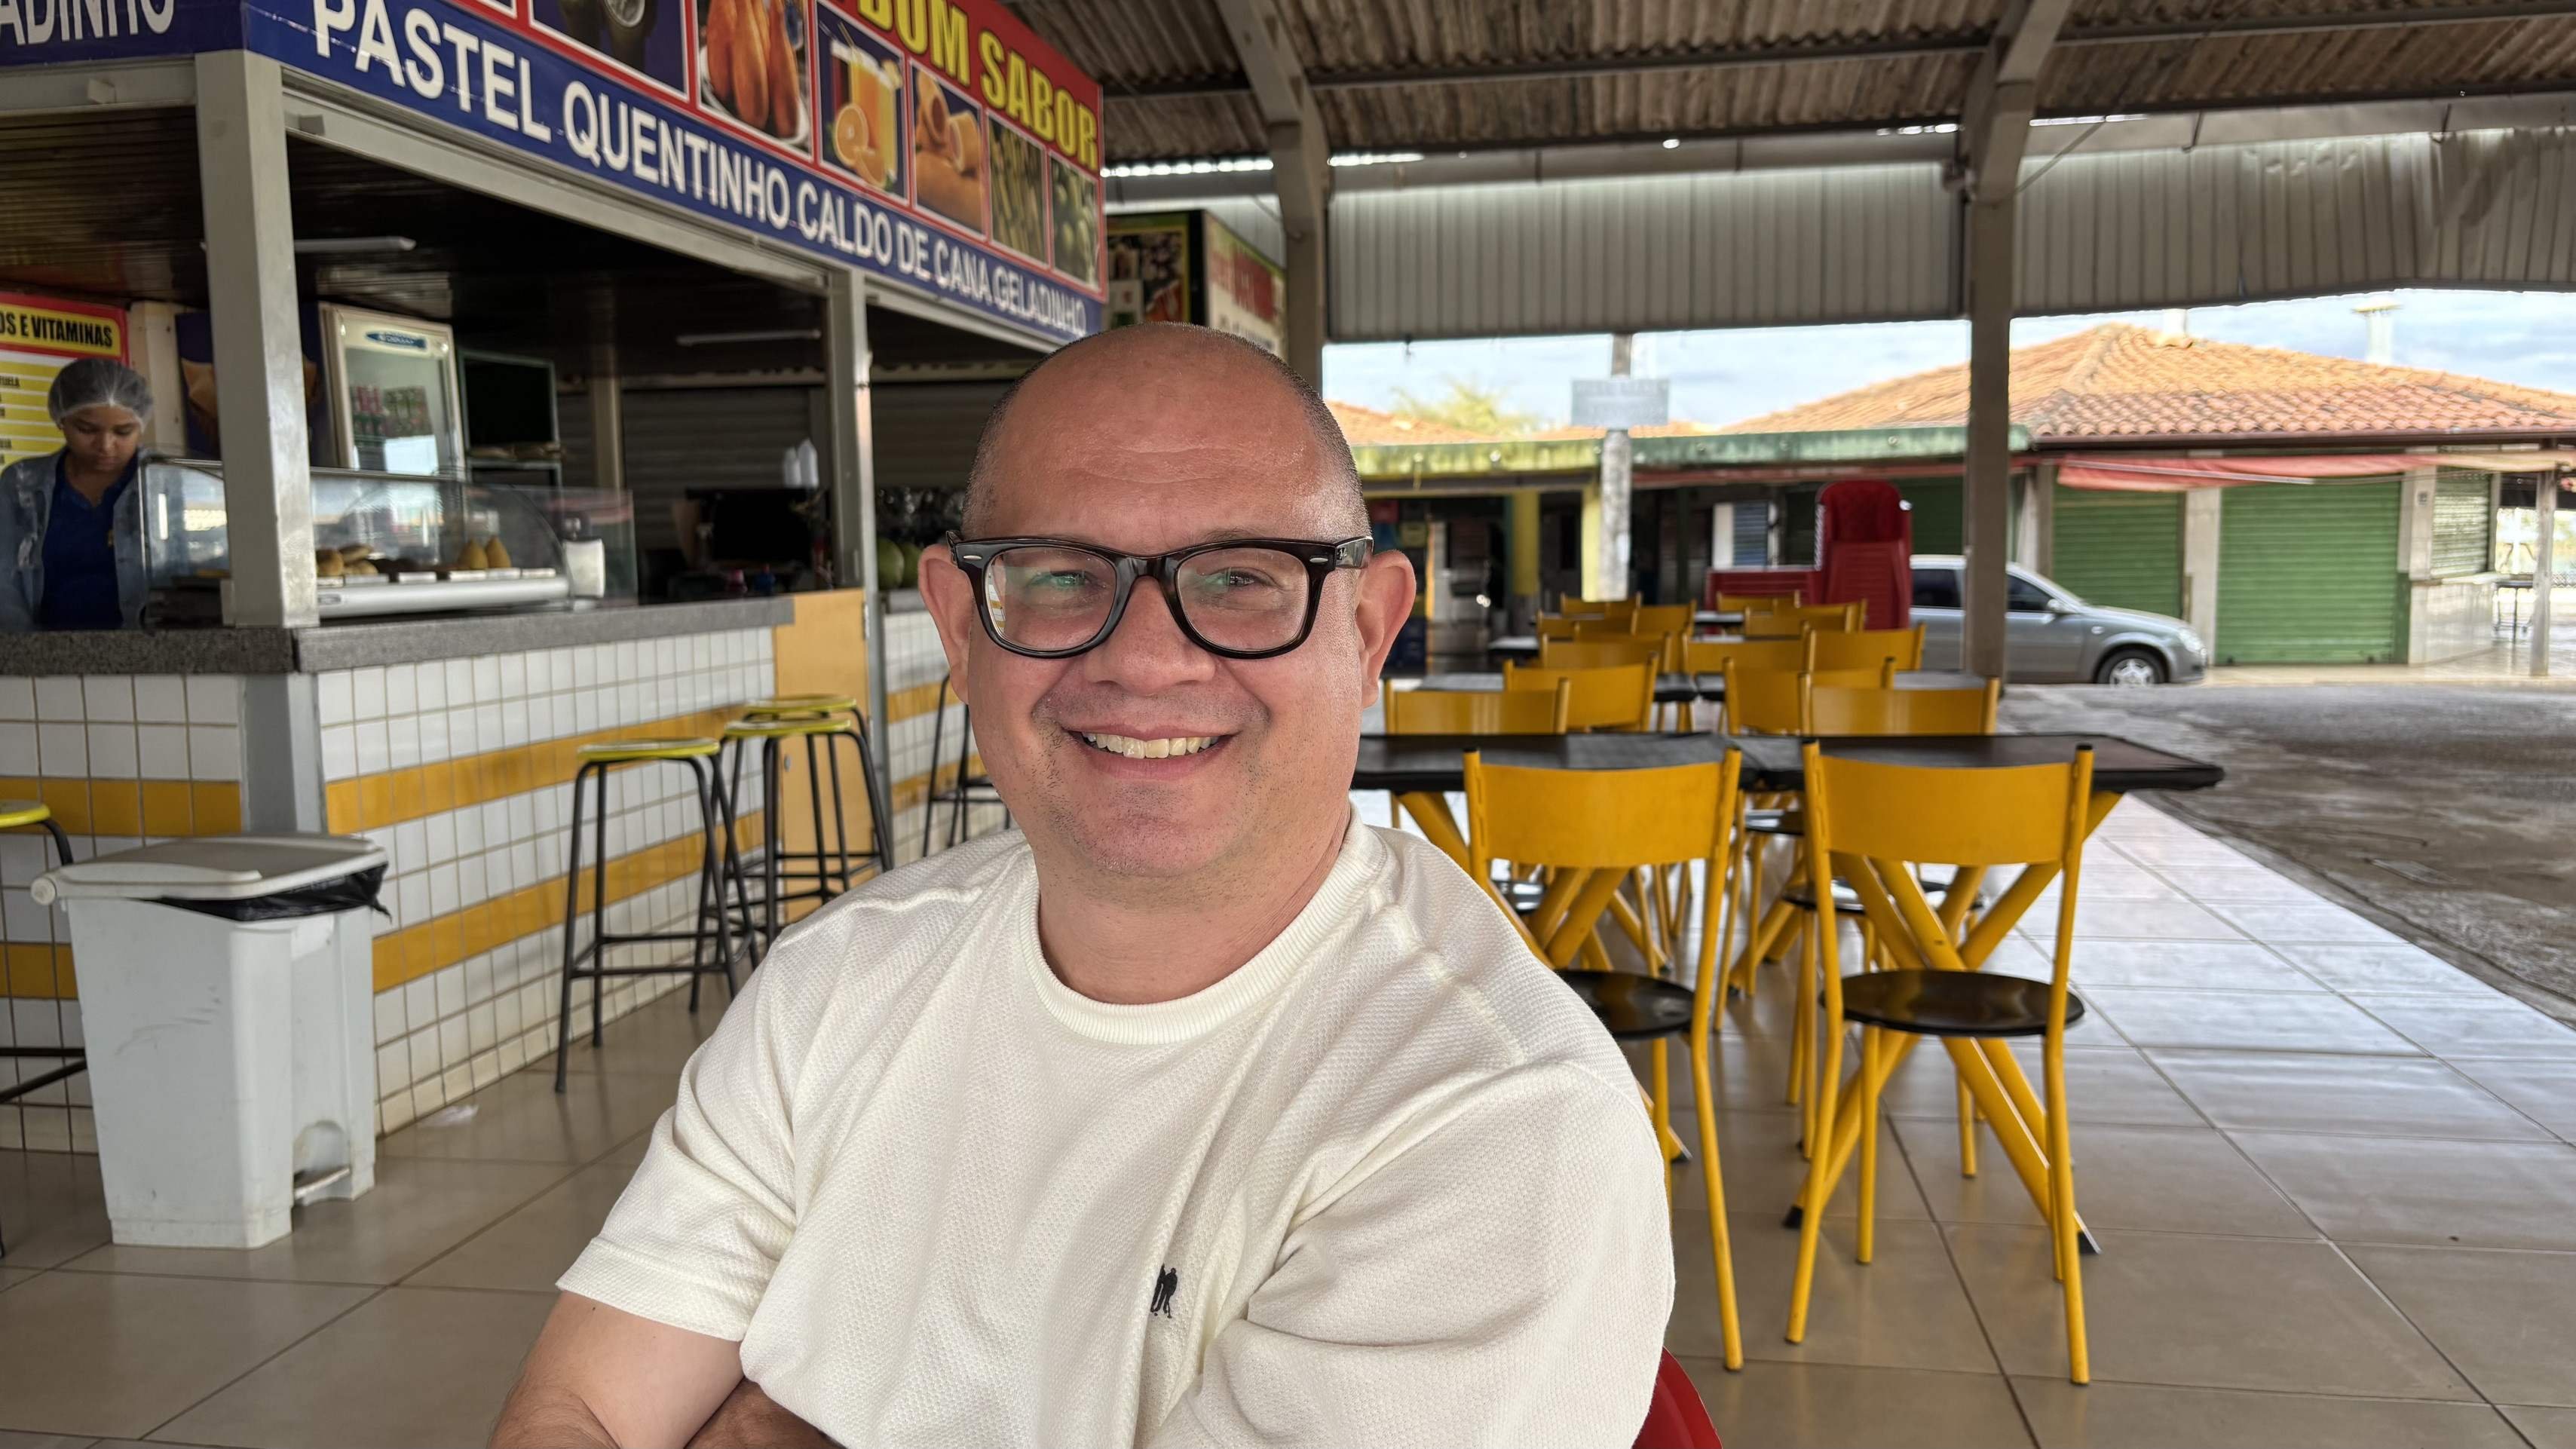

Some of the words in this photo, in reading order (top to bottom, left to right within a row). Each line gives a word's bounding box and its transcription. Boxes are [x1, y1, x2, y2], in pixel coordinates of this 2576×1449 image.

[313, 0, 552, 143] PASTEL
[563, 80, 790, 230] QUENTINHO
[797, 180, 893, 267] CALDO
[896, 220, 931, 281] DE
[933, 238, 992, 306] CANA
[992, 265, 1086, 338] GELADINHO
[978, 30, 1098, 172] SABOR
[20, 314, 29, 337] E
[31, 315, 112, 348] VITAMINAS
